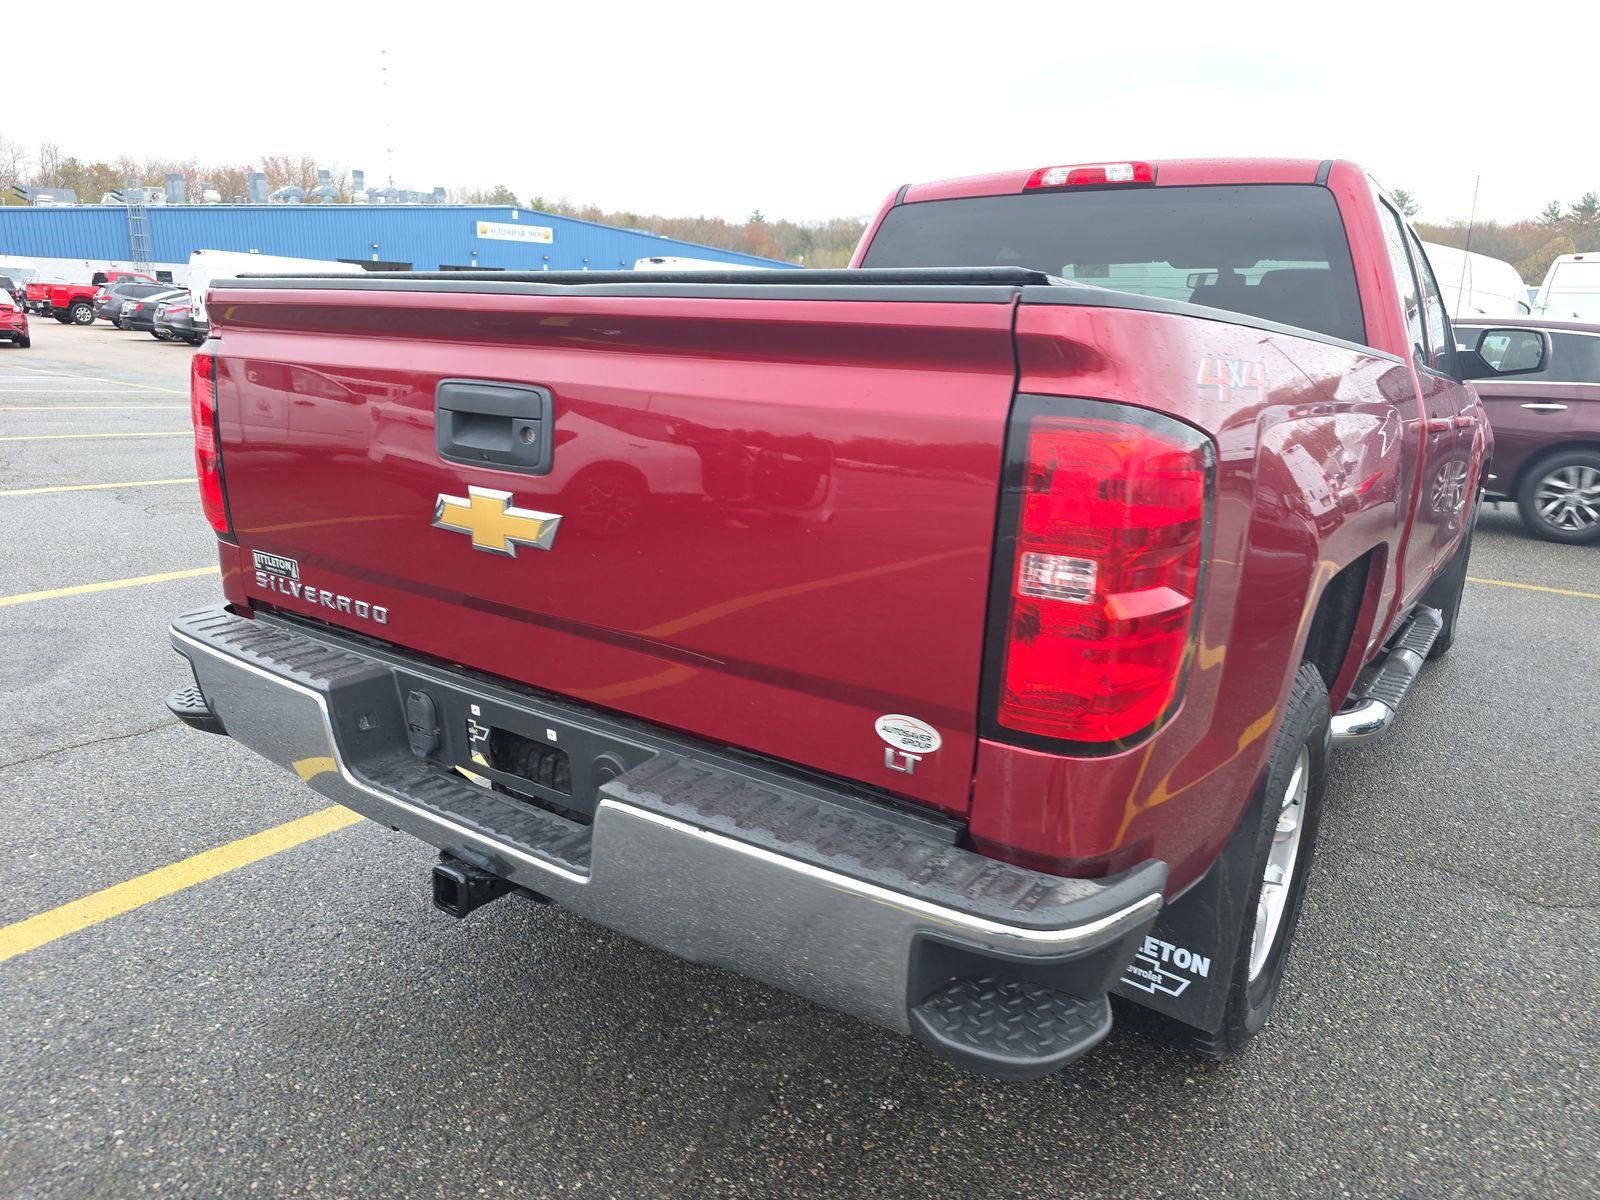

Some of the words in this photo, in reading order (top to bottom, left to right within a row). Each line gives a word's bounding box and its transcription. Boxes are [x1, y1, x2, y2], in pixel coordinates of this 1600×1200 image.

[254, 552, 292, 571] LITTLETON
[256, 571, 388, 625] SILVERADO
[880, 725, 933, 742] AUTOSAVER
[901, 737, 933, 749] GROUP
[884, 747, 922, 775] LT
[1139, 935, 1211, 978] ETON
